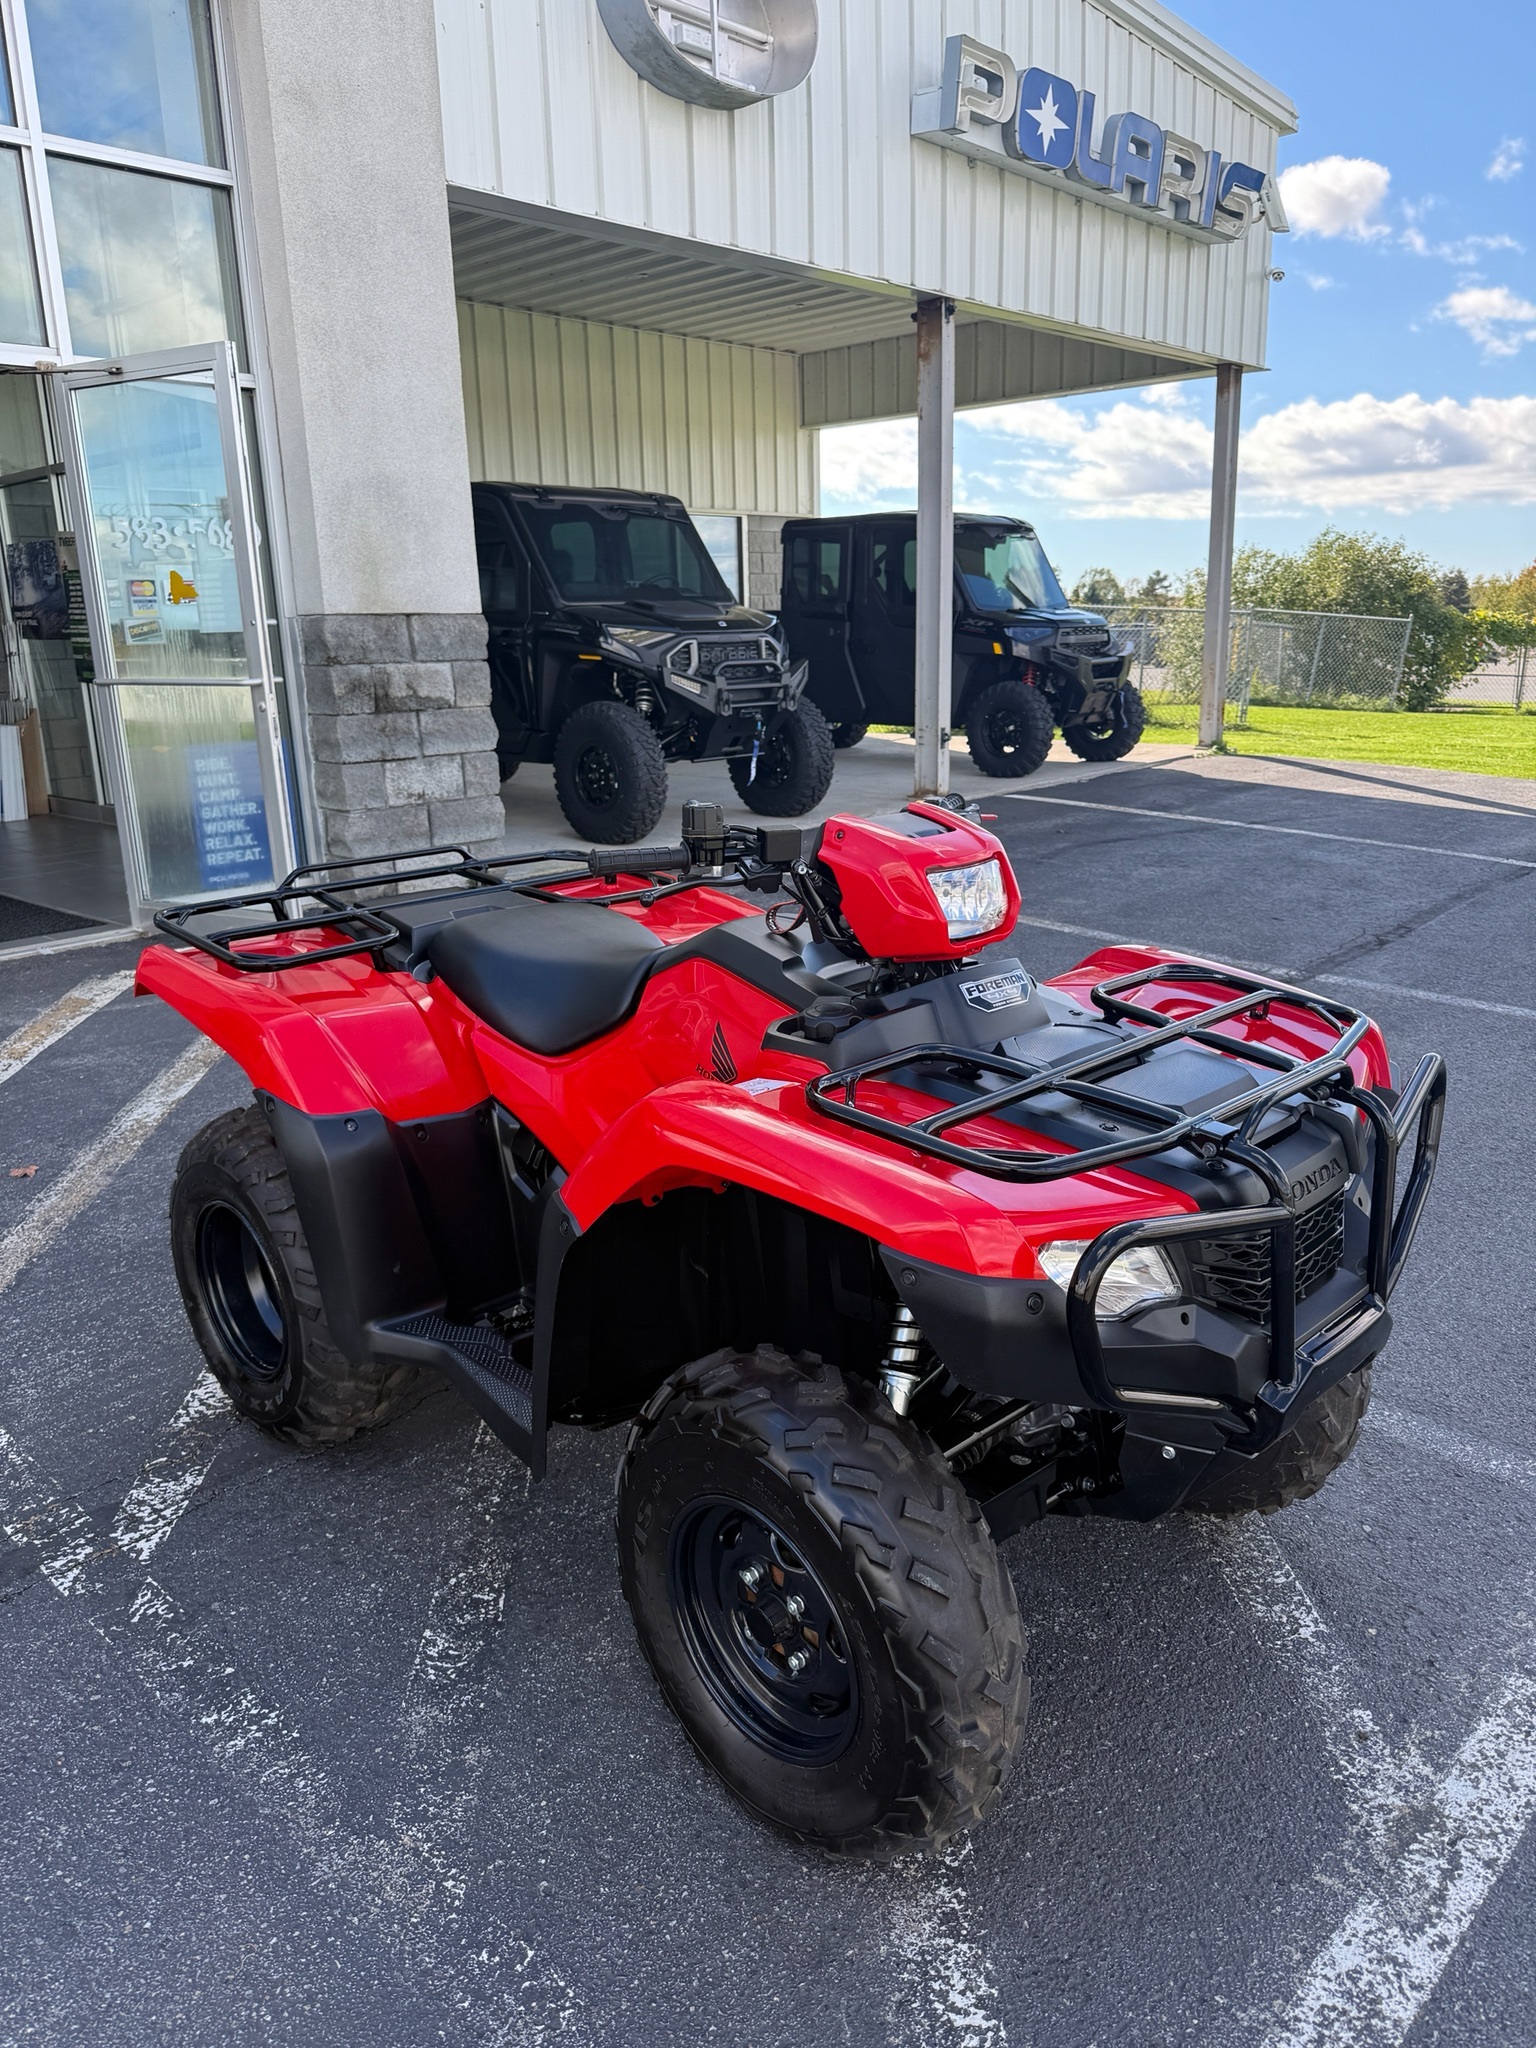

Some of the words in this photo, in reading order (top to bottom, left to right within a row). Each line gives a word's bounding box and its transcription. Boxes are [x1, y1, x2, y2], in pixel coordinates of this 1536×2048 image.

[940, 33, 1266, 241] POLARIS
[961, 617, 994, 626] XP
[700, 650, 758, 663] POLARIS
[201, 802, 261, 820] GATHER.
[203, 819, 250, 835] WORK.
[205, 833, 258, 850] RELAX.
[206, 848, 265, 866] REPEAT.
[964, 973, 1026, 997] FOREMAN
[1291, 1157, 1344, 1202] ONDA
